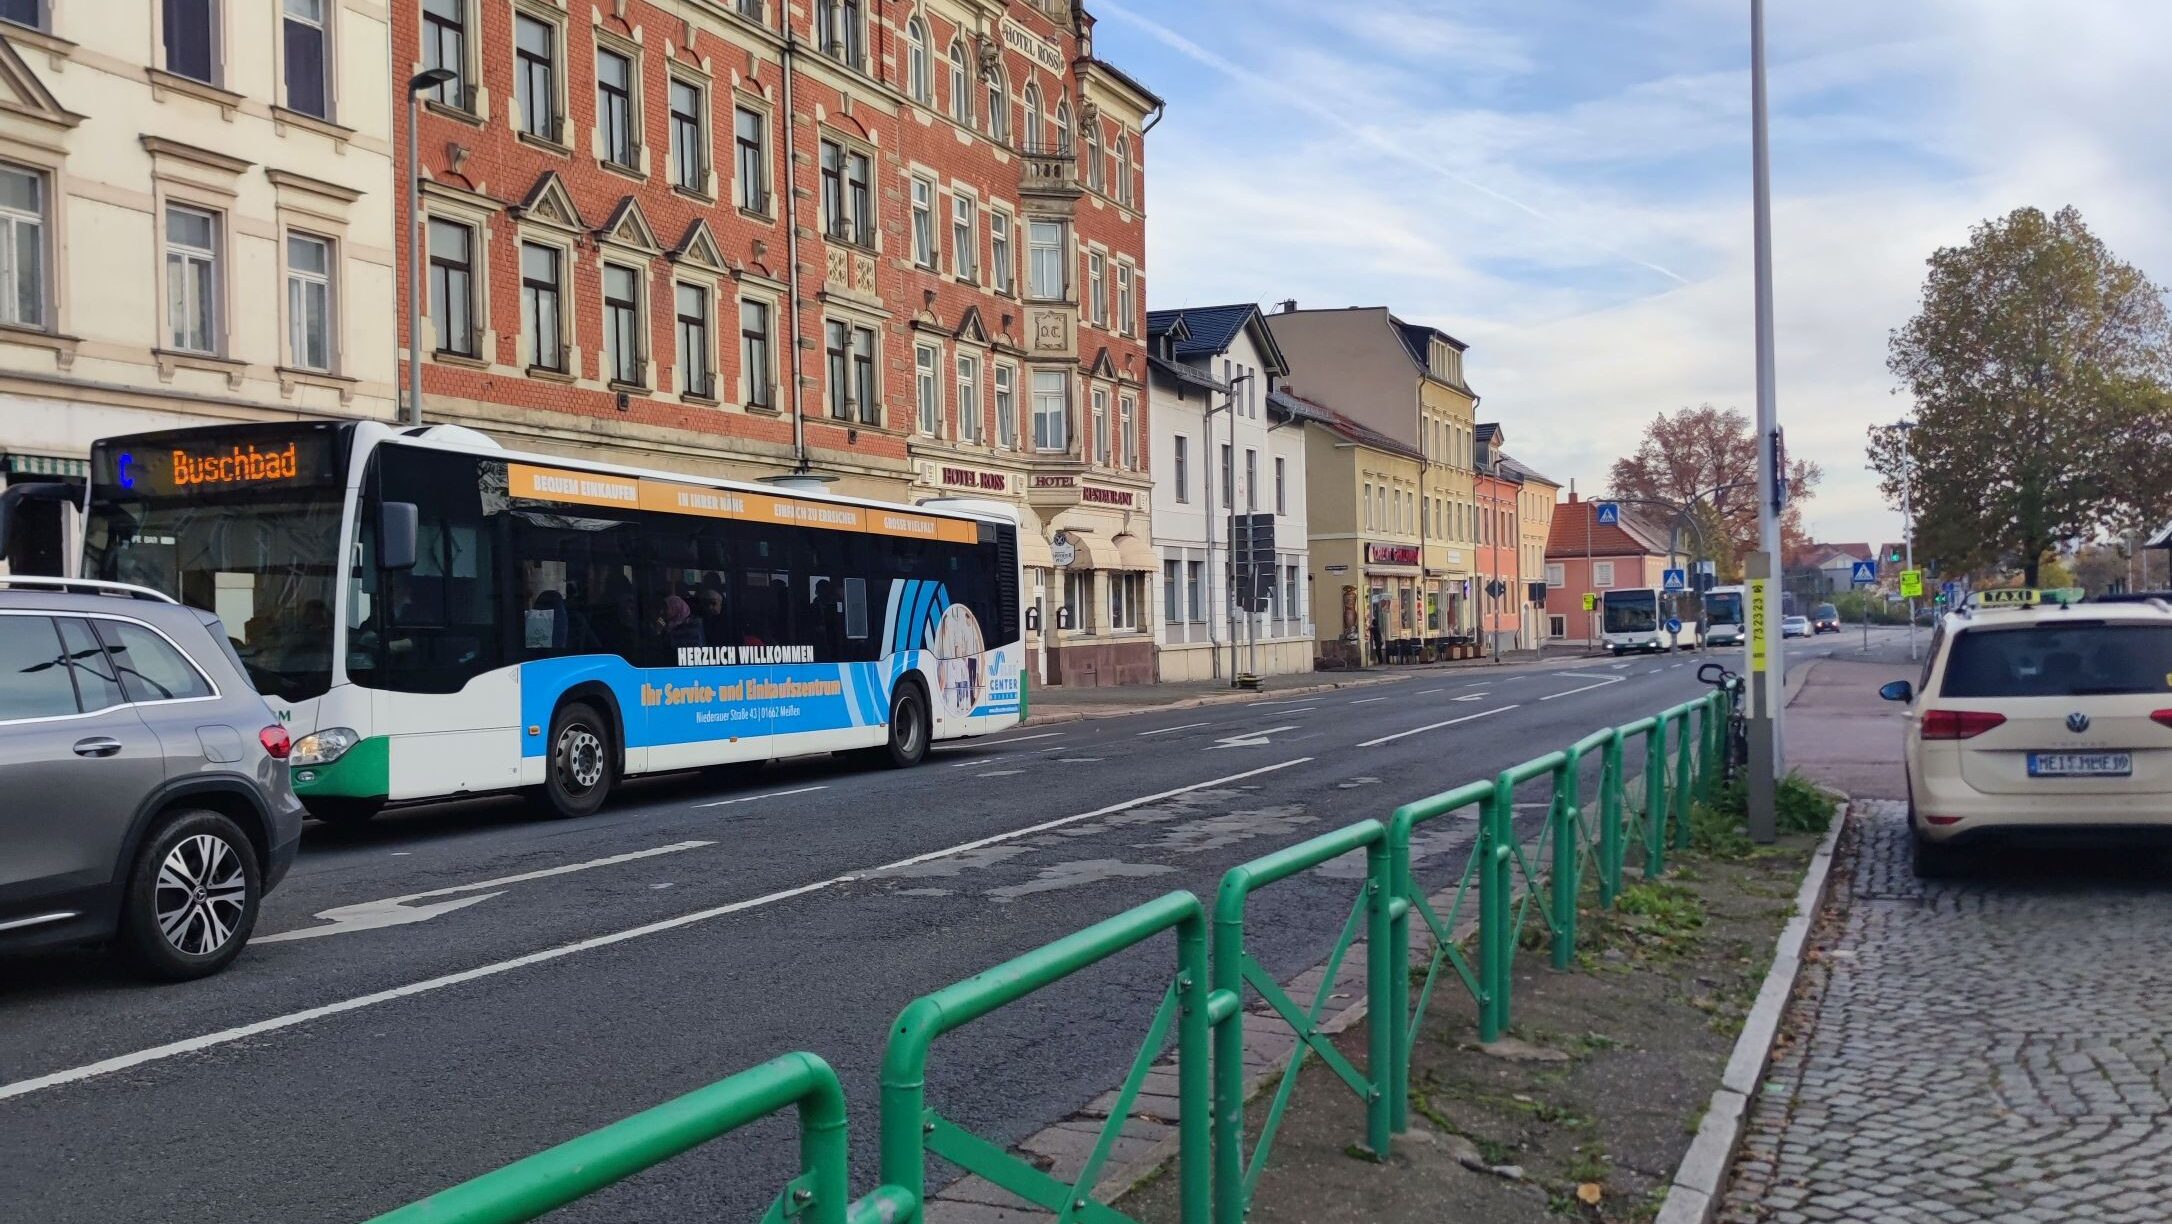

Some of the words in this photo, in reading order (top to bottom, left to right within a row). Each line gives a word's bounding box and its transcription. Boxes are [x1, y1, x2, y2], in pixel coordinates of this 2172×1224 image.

[1005, 26, 1035, 57] HOTEL
[1037, 43, 1059, 70] ROSS
[119, 453, 134, 489] C
[173, 441, 296, 485] Buschbad
[533, 474, 579, 495] BEQUEM
[580, 480, 637, 501] EINKAUFEN
[943, 467, 979, 487] HOTEL
[980, 472, 1005, 490] ROSS
[1035, 476, 1077, 487] HOTEL
[1082, 486, 1133, 506] RESTAURANT
[907, 518, 935, 534] VIELFALT
[1989, 589, 2029, 602] TAXI
[677, 647, 736, 666] HERZLICH
[738, 645, 814, 663] WILLKOMMEN
[640, 683, 662, 706] Ihr
[665, 680, 716, 705] Service-
[719, 679, 743, 702] und
[746, 675, 841, 700] Einkaufszentrum
[990, 678, 1018, 690] CENTER
[696, 710, 730, 723] Niederauer
[730, 708, 749, 720] Straße
